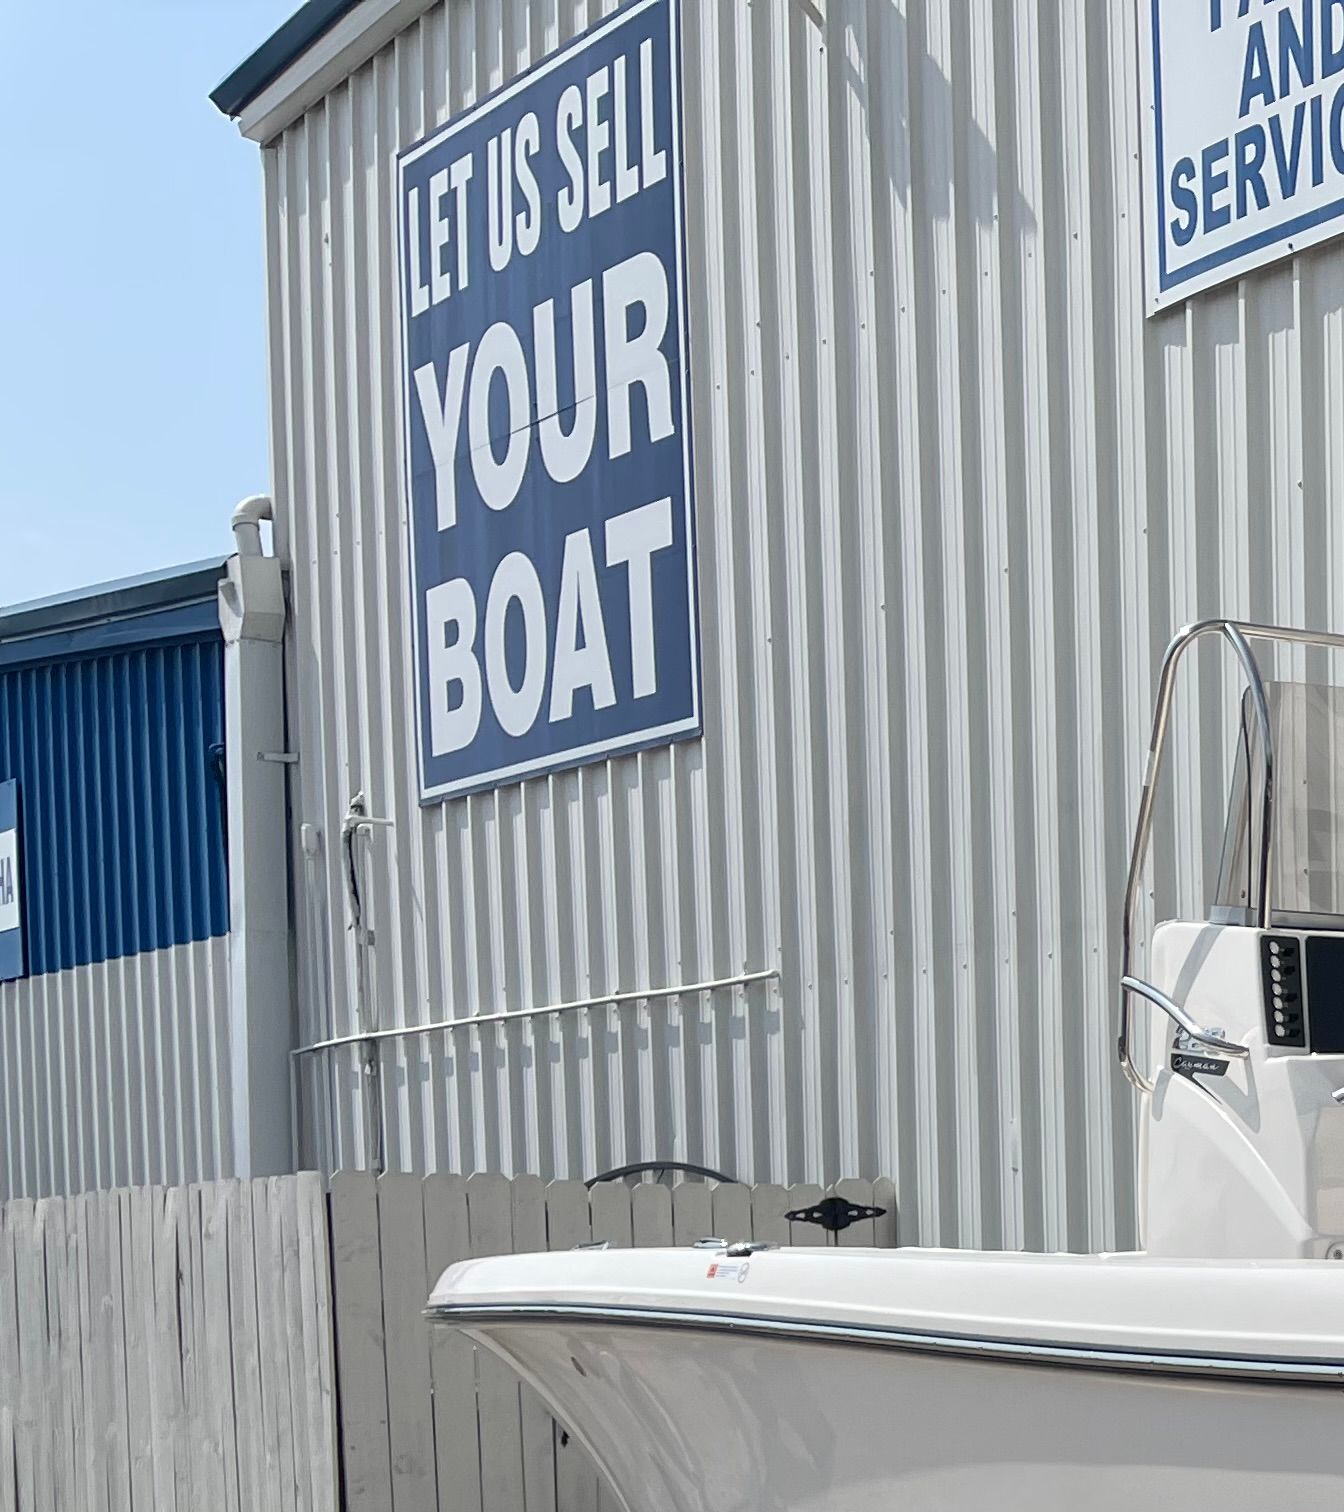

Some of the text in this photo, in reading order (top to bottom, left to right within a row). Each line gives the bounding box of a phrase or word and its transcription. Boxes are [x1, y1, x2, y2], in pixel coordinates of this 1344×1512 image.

[408, 37, 667, 318] LET US SELL
[414, 251, 675, 532] YOUR
[425, 496, 673, 757] BOAT
[1173, 1056, 1220, 1071] Cayman
